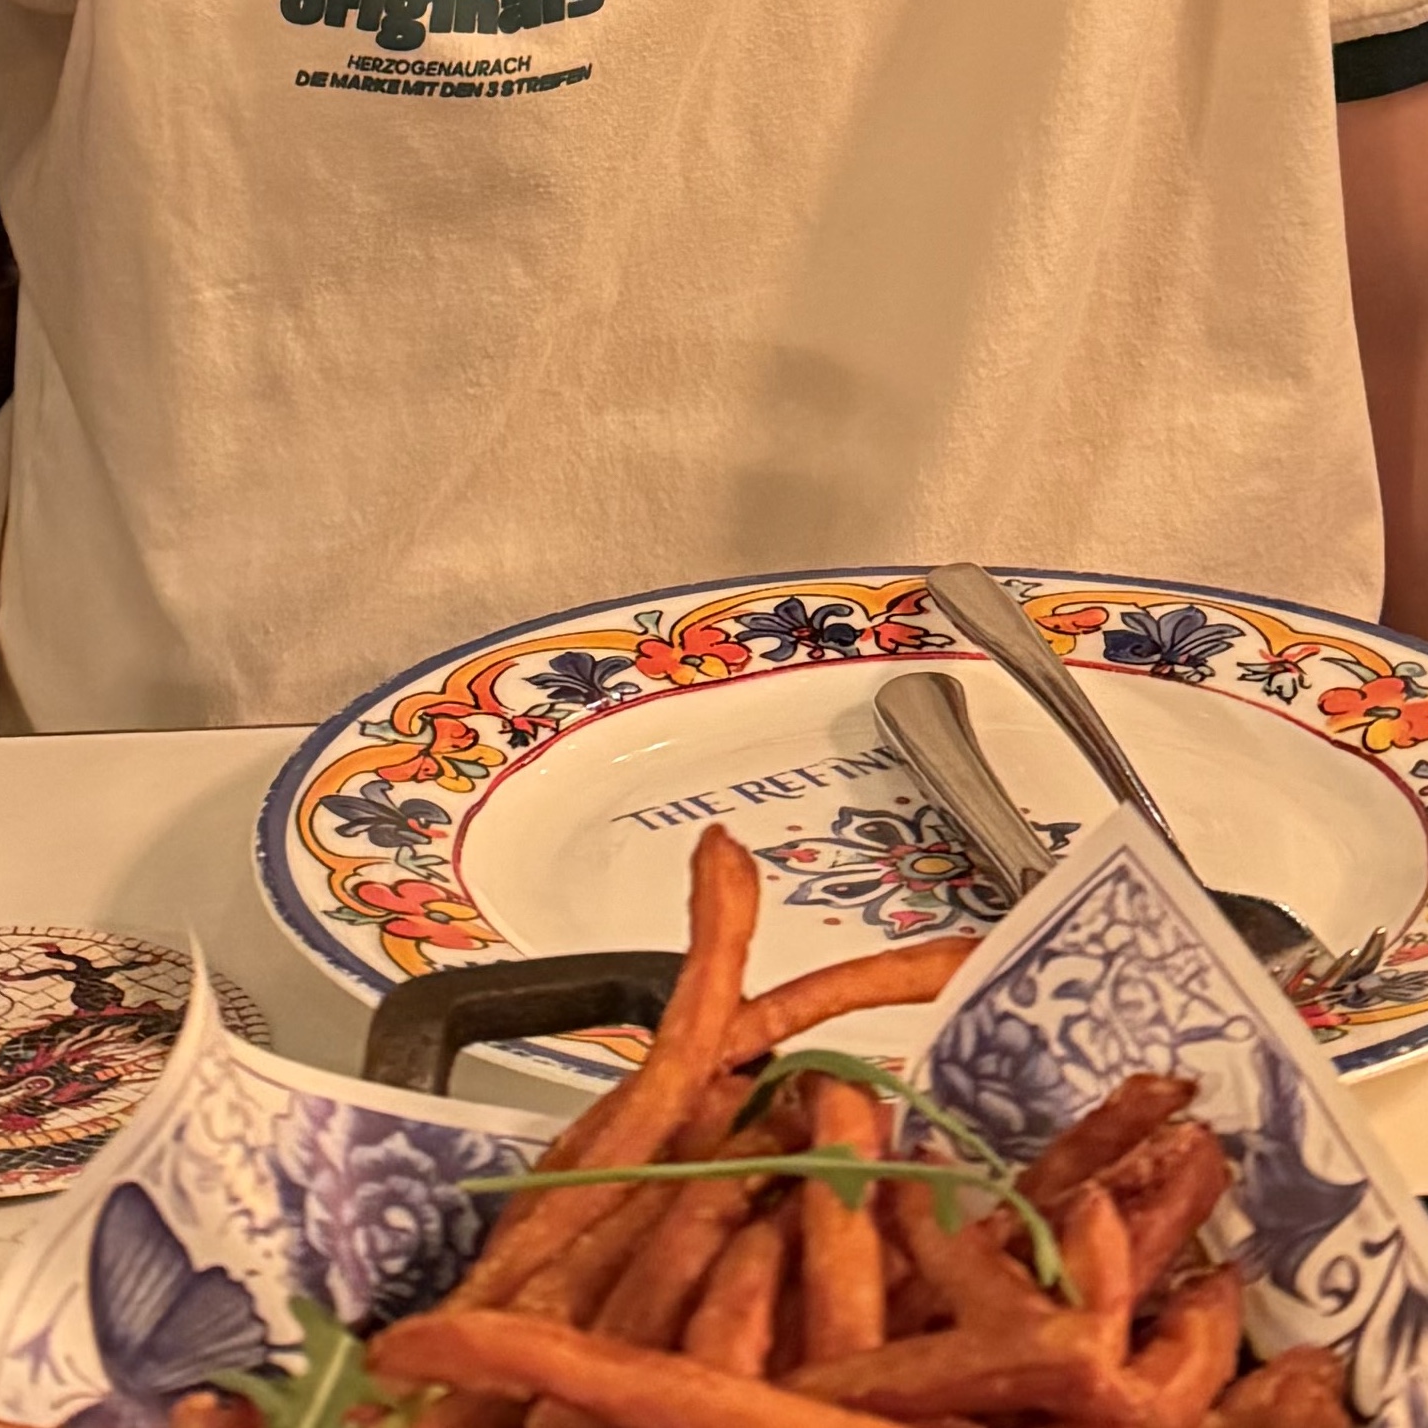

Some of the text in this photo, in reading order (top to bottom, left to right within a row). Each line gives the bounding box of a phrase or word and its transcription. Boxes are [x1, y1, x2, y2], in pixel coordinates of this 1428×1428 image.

[347, 55, 532, 77] HERZOGENAURACH
[329, 71, 401, 95] MARKE
[401, 78, 440, 97] MIT
[611, 790, 736, 831] THE
